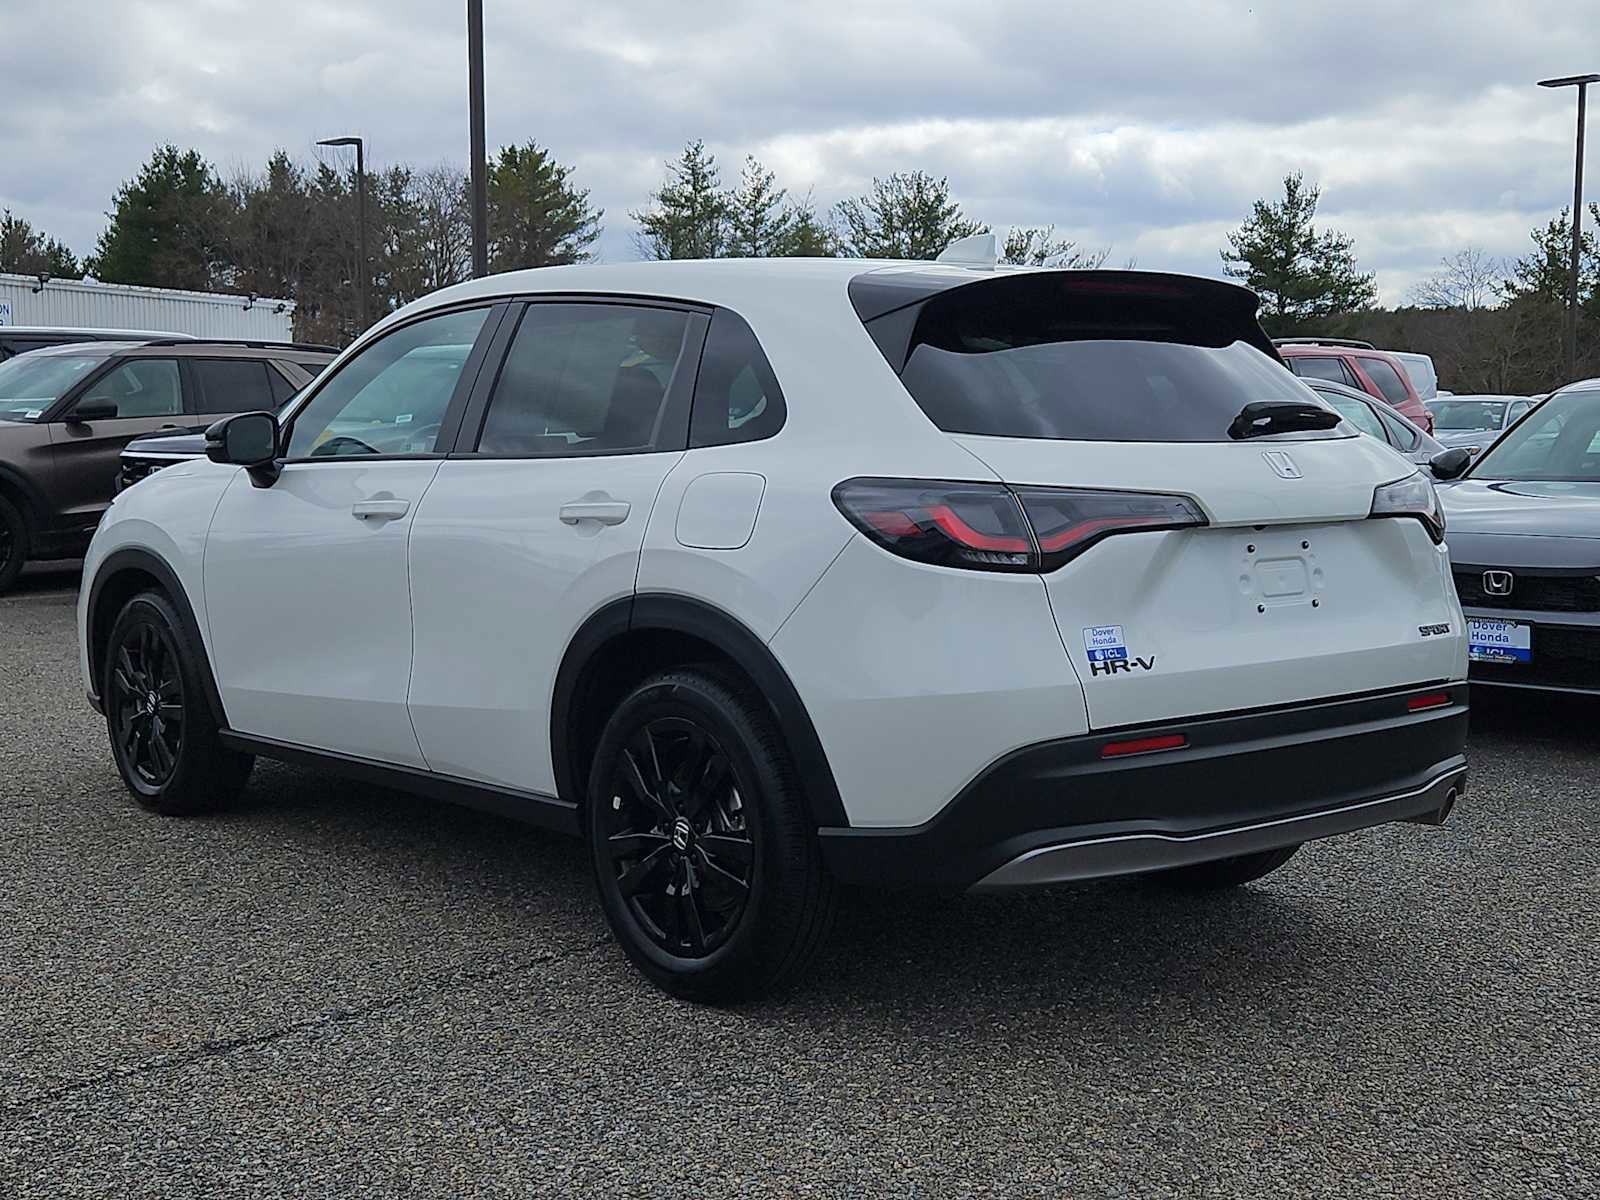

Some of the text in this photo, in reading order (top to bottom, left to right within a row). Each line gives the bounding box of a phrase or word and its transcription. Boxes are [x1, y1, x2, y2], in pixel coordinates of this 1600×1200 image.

[1419, 623, 1450, 636] SPORT
[1473, 622, 1507, 632] Dover
[1092, 637, 1117, 645] Honda
[1472, 631, 1509, 643] Honda
[1090, 656, 1155, 676] HR-V
